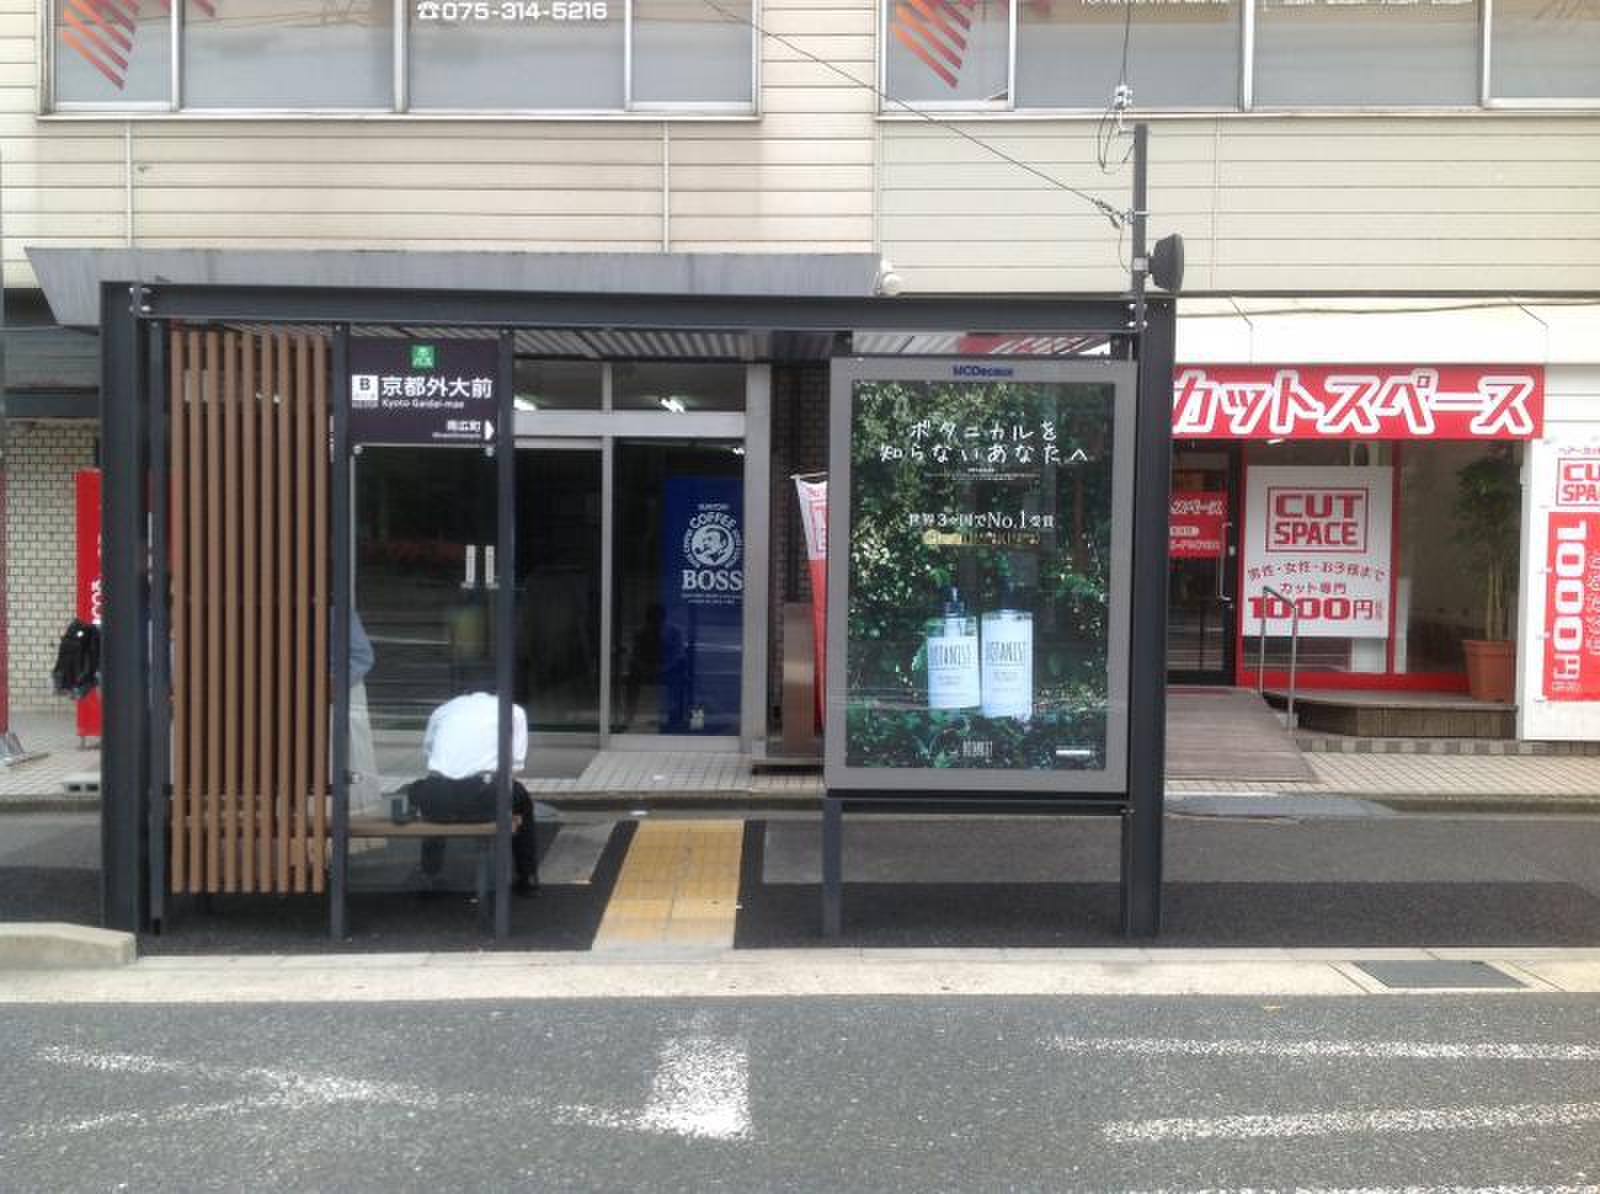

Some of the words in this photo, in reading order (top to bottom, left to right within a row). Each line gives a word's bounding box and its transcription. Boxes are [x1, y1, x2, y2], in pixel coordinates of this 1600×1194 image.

[441, 2, 608, 19] 075-314-5216
[381, 376, 493, 399] 京都外大前
[382, 399, 411, 410] Kyoto
[1174, 368, 1535, 436] カットスペース
[911, 421, 1057, 441] ボタニカルを
[879, 443, 1089, 465] 知らないあなたへ
[1561, 484, 1600, 502] SPA
[1275, 493, 1363, 518] CUT
[689, 511, 737, 530] COFFEE
[1274, 521, 1359, 545] SPACE
[681, 569, 744, 591] BOSS
[1280, 582, 1347, 595] カット専門
[1247, 596, 1374, 621] 1000円
[1553, 519, 1588, 680] 1000円
